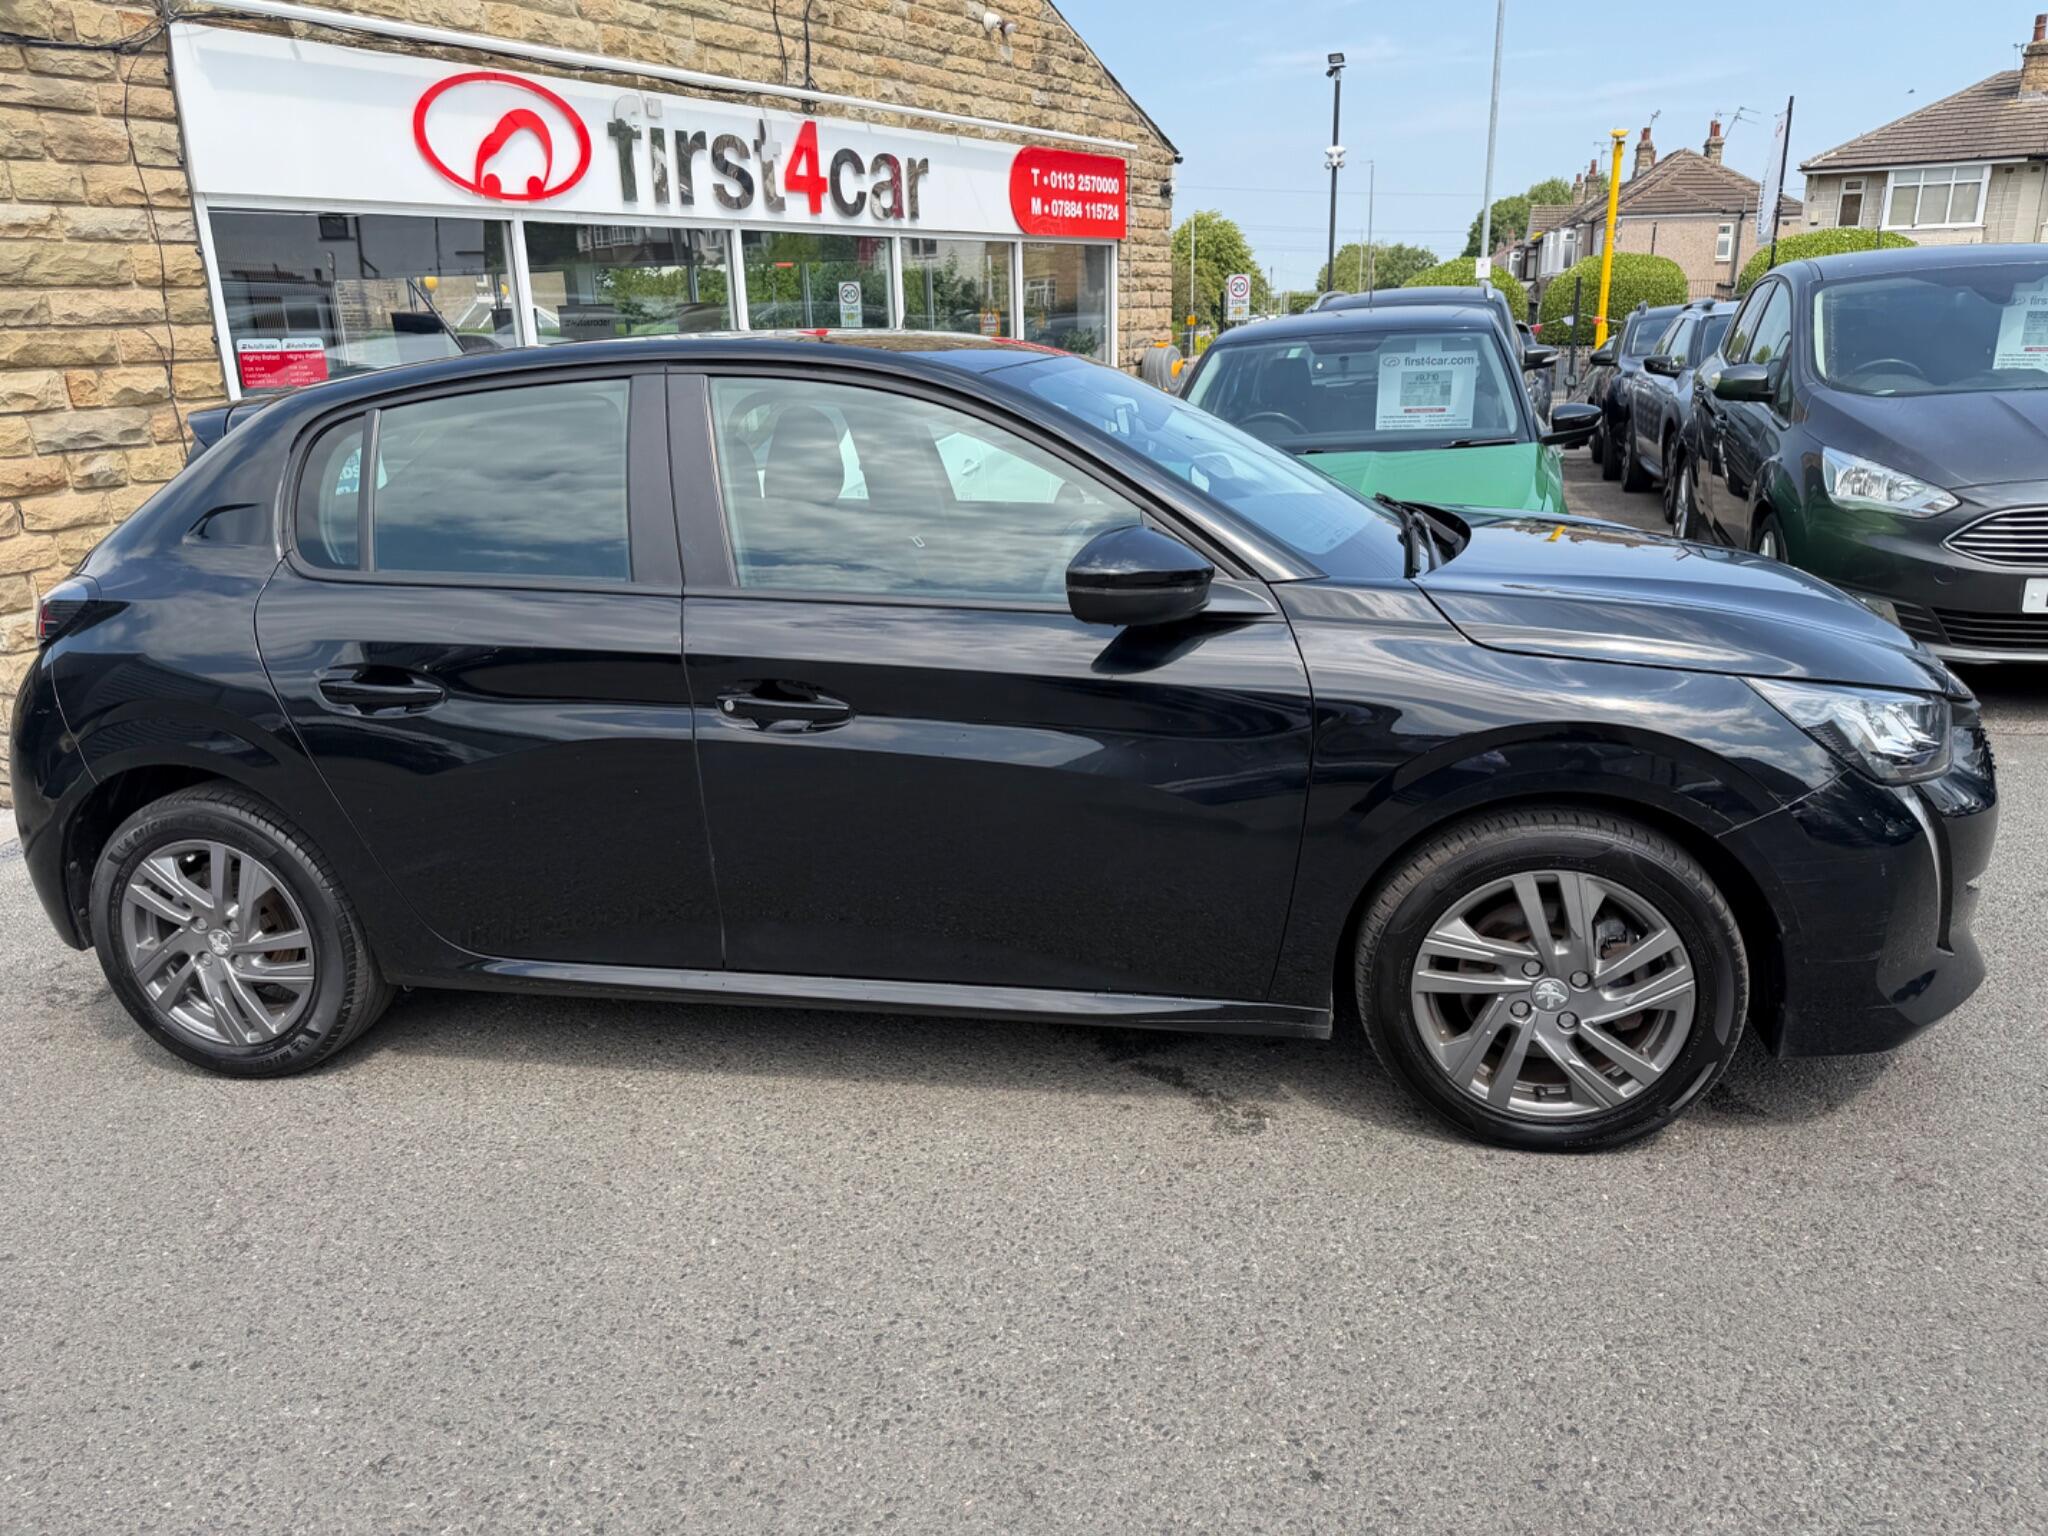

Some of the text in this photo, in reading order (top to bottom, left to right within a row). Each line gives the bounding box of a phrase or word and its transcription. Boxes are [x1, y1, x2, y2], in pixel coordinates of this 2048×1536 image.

[606, 94, 929, 221] first4car
[1031, 168, 1119, 194] T 0113 2570000
[1031, 197, 1119, 220] M 07884 115724
[843, 288, 856, 299] 20
[1233, 281, 1246, 292] 20
[1404, 356, 1474, 367] first4car.com
